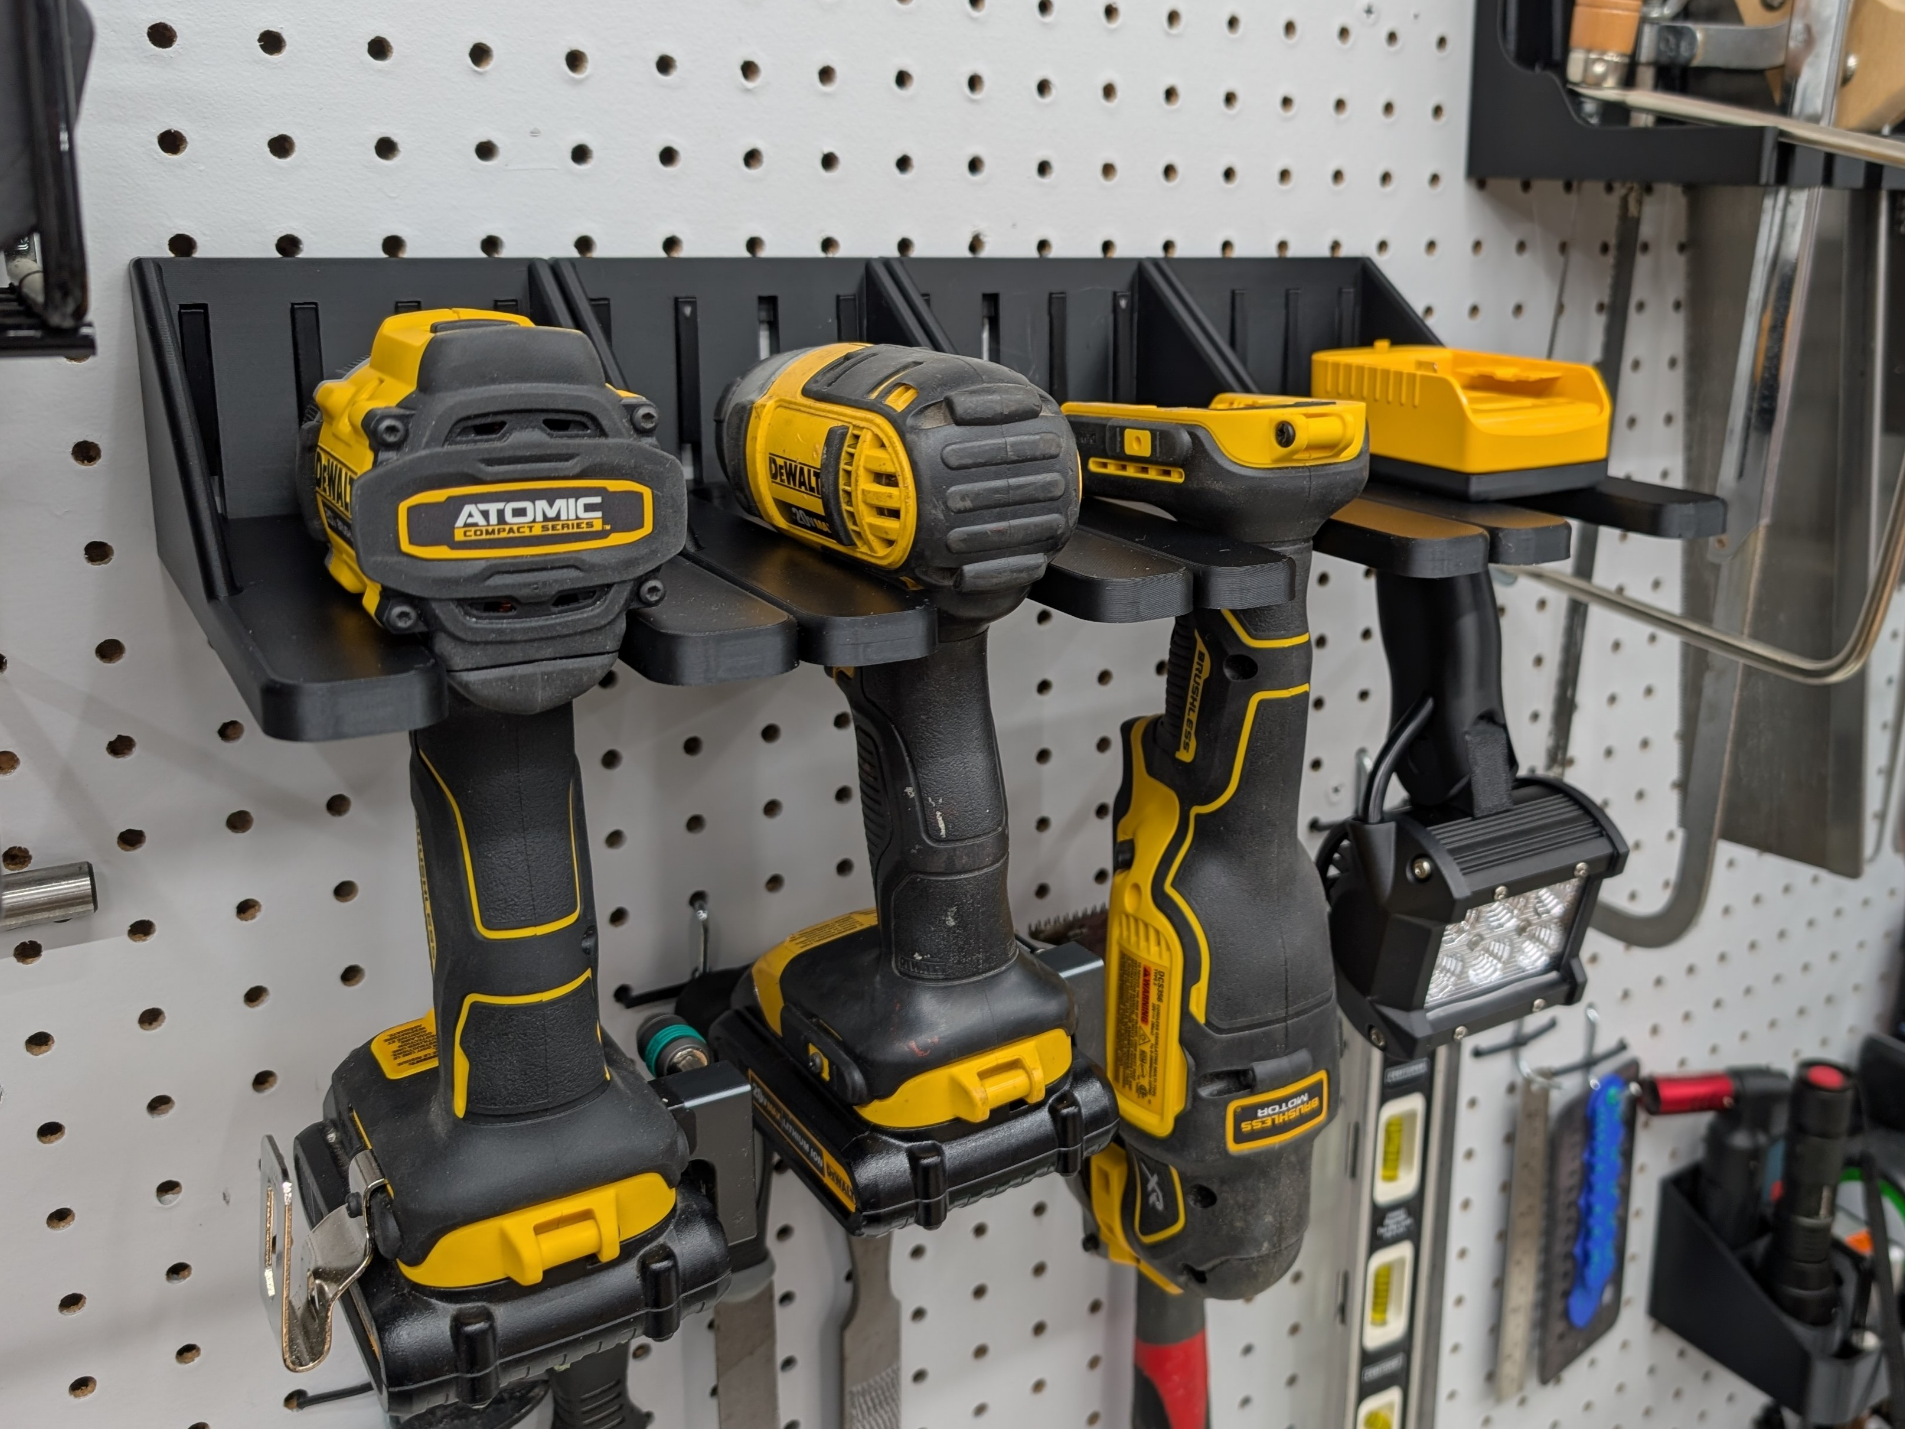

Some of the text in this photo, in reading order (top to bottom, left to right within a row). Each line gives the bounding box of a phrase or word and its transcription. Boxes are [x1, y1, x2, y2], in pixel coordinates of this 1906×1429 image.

[455, 496, 602, 528] ATOMIC
[463, 525, 535, 538] COMPACT
[541, 520, 594, 532] SERIES
[1182, 650, 1205, 753] BRUSHLESS
[1141, 980, 1150, 1023] WARNING
[1241, 1096, 1320, 1133] BRUSHLESS
[1257, 1093, 1309, 1118] MOTOR
[781, 1118, 810, 1153] LITHIUM
[810, 1148, 823, 1168] ION
